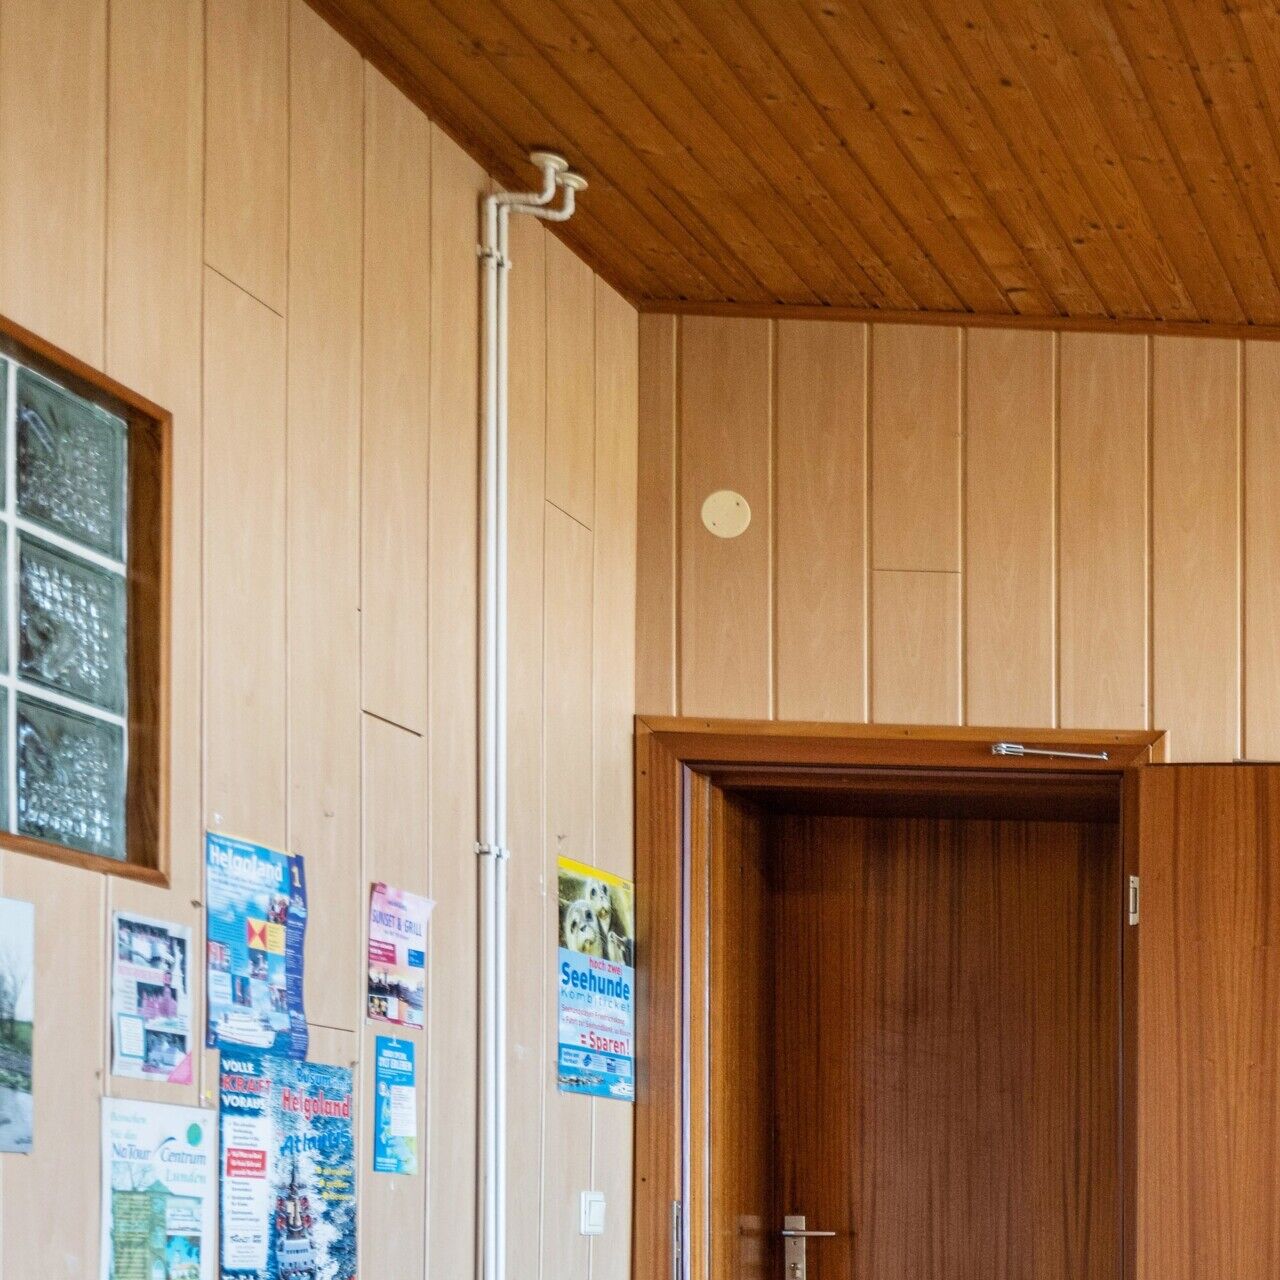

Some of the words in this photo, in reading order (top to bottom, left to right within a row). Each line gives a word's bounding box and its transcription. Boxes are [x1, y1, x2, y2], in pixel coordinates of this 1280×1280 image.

[209, 844, 283, 882] Helgoland
[372, 910, 396, 927] SUNSET
[404, 919, 422, 936] GRILL
[589, 957, 607, 971] hoch
[561, 962, 630, 1000] Seehunde
[589, 1031, 630, 1055] Sparen!
[222, 1060, 255, 1074] VOLLE
[222, 1074, 272, 1092] KRAFT
[282, 1087, 352, 1120] Helgoland
[160, 1147, 206, 1165] Centrum
